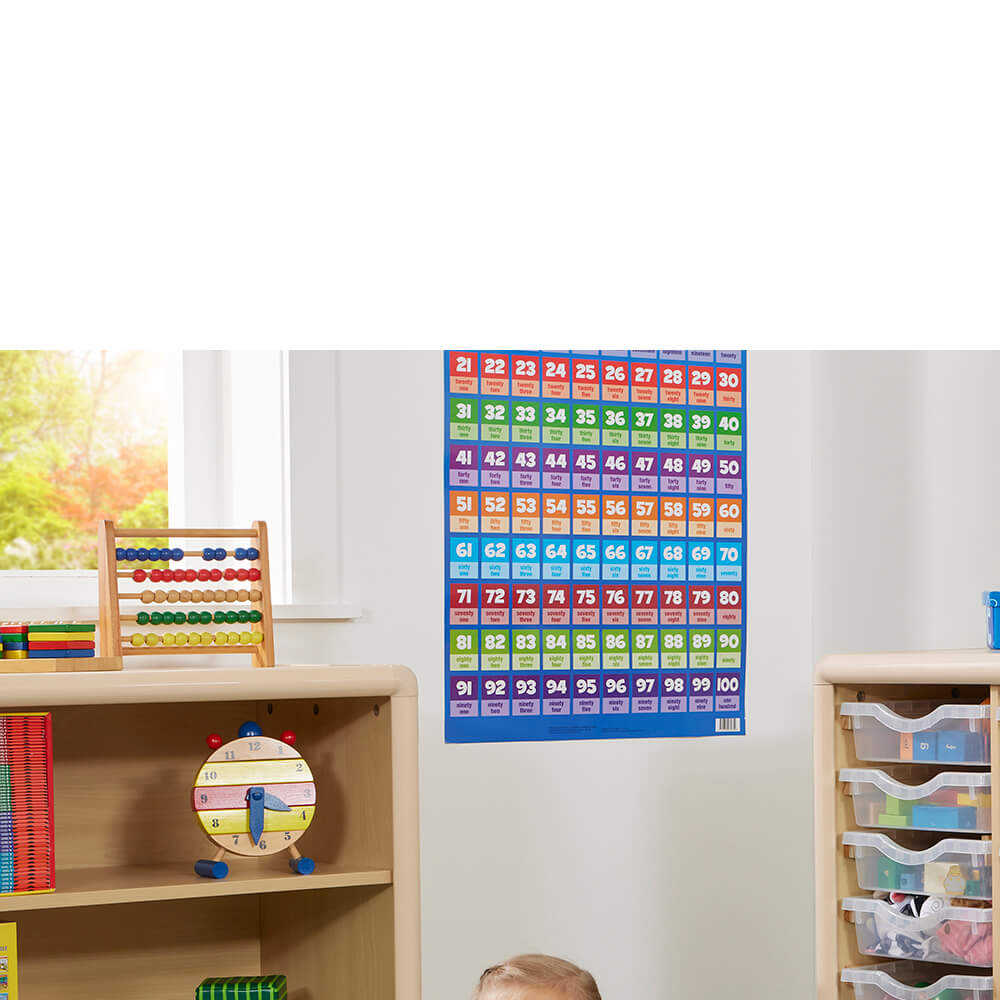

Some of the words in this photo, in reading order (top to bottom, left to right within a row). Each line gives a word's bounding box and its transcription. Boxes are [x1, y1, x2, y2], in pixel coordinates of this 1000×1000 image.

[456, 357, 471, 372] 21
[485, 359, 505, 374] 22
[516, 360, 535, 375] 23
[546, 362, 566, 377] 24
[576, 364, 595, 379] 25
[606, 366, 625, 381] 26
[635, 368, 653, 382] 27
[664, 369, 682, 384] 28
[692, 371, 710, 385] 29
[719, 373, 738, 387] 30
[456, 403, 471, 418] 31
[485, 405, 505, 420] 32
[516, 406, 535, 421] 33
[546, 408, 566, 422] 34
[576, 409, 595, 424] 35
[606, 411, 625, 425] 36
[636, 412, 653, 426] 37
[664, 414, 682, 428] 38
[692, 415, 710, 429] 39
[719, 417, 739, 431] 40
[456, 451, 471, 464] 41
[485, 451, 505, 465] 42
[516, 452, 536, 467] 43
[546, 454, 566, 468] 44
[576, 455, 596, 469] 45
[605, 456, 625, 470] 46
[636, 457, 653, 471] 47
[664, 458, 683, 472] 48
[692, 459, 711, 473] 49
[720, 460, 739, 474] 50
[457, 496, 471, 511] 51
[486, 497, 505, 512] 52
[517, 498, 536, 513] 53
[547, 499, 566, 513] 54
[577, 500, 596, 514] 55
[606, 501, 626, 515] 56
[636, 502, 653, 516] 57
[664, 502, 682, 516] 58
[693, 503, 710, 517] 59
[720, 504, 739, 518] 60
[456, 543, 472, 557] 61
[485, 543, 505, 557] 62
[516, 544, 536, 558] 63
[546, 544, 567, 558] 64
[576, 545, 596, 559] 65
[605, 545, 625, 559] 66
[636, 546, 653, 560] 67
[663, 546, 682, 560] 68
[692, 547, 710, 560] 69
[720, 548, 738, 561] 70
[457, 589, 471, 603] 71
[486, 589, 505, 603] 72
[517, 589, 535, 604] 73
[548, 590, 565, 603] 74
[577, 590, 595, 604] 75
[607, 590, 624, 604] 76
[636, 591, 653, 604] 77
[664, 591, 682, 604] 78
[693, 591, 710, 604] 79
[720, 591, 739, 605] 80
[457, 635, 471, 649] 81
[485, 635, 505, 649] 82
[516, 635, 536, 649] 83
[546, 635, 566, 649] 84
[576, 635, 595, 649] 85
[606, 635, 625, 648] 86
[636, 635, 653, 648] 87
[664, 635, 683, 648] 88
[693, 634, 711, 648] 89
[720, 634, 739, 648] 90
[457, 681, 471, 695] 91
[485, 680, 505, 694] 92
[516, 680, 536, 694] 93
[547, 680, 567, 693] 94
[577, 679, 596, 694] 95
[606, 679, 626, 693] 96
[637, 679, 654, 692] 97
[665, 678, 683, 692] 98
[693, 678, 710, 691] 99
[717, 678, 738, 691] 100
